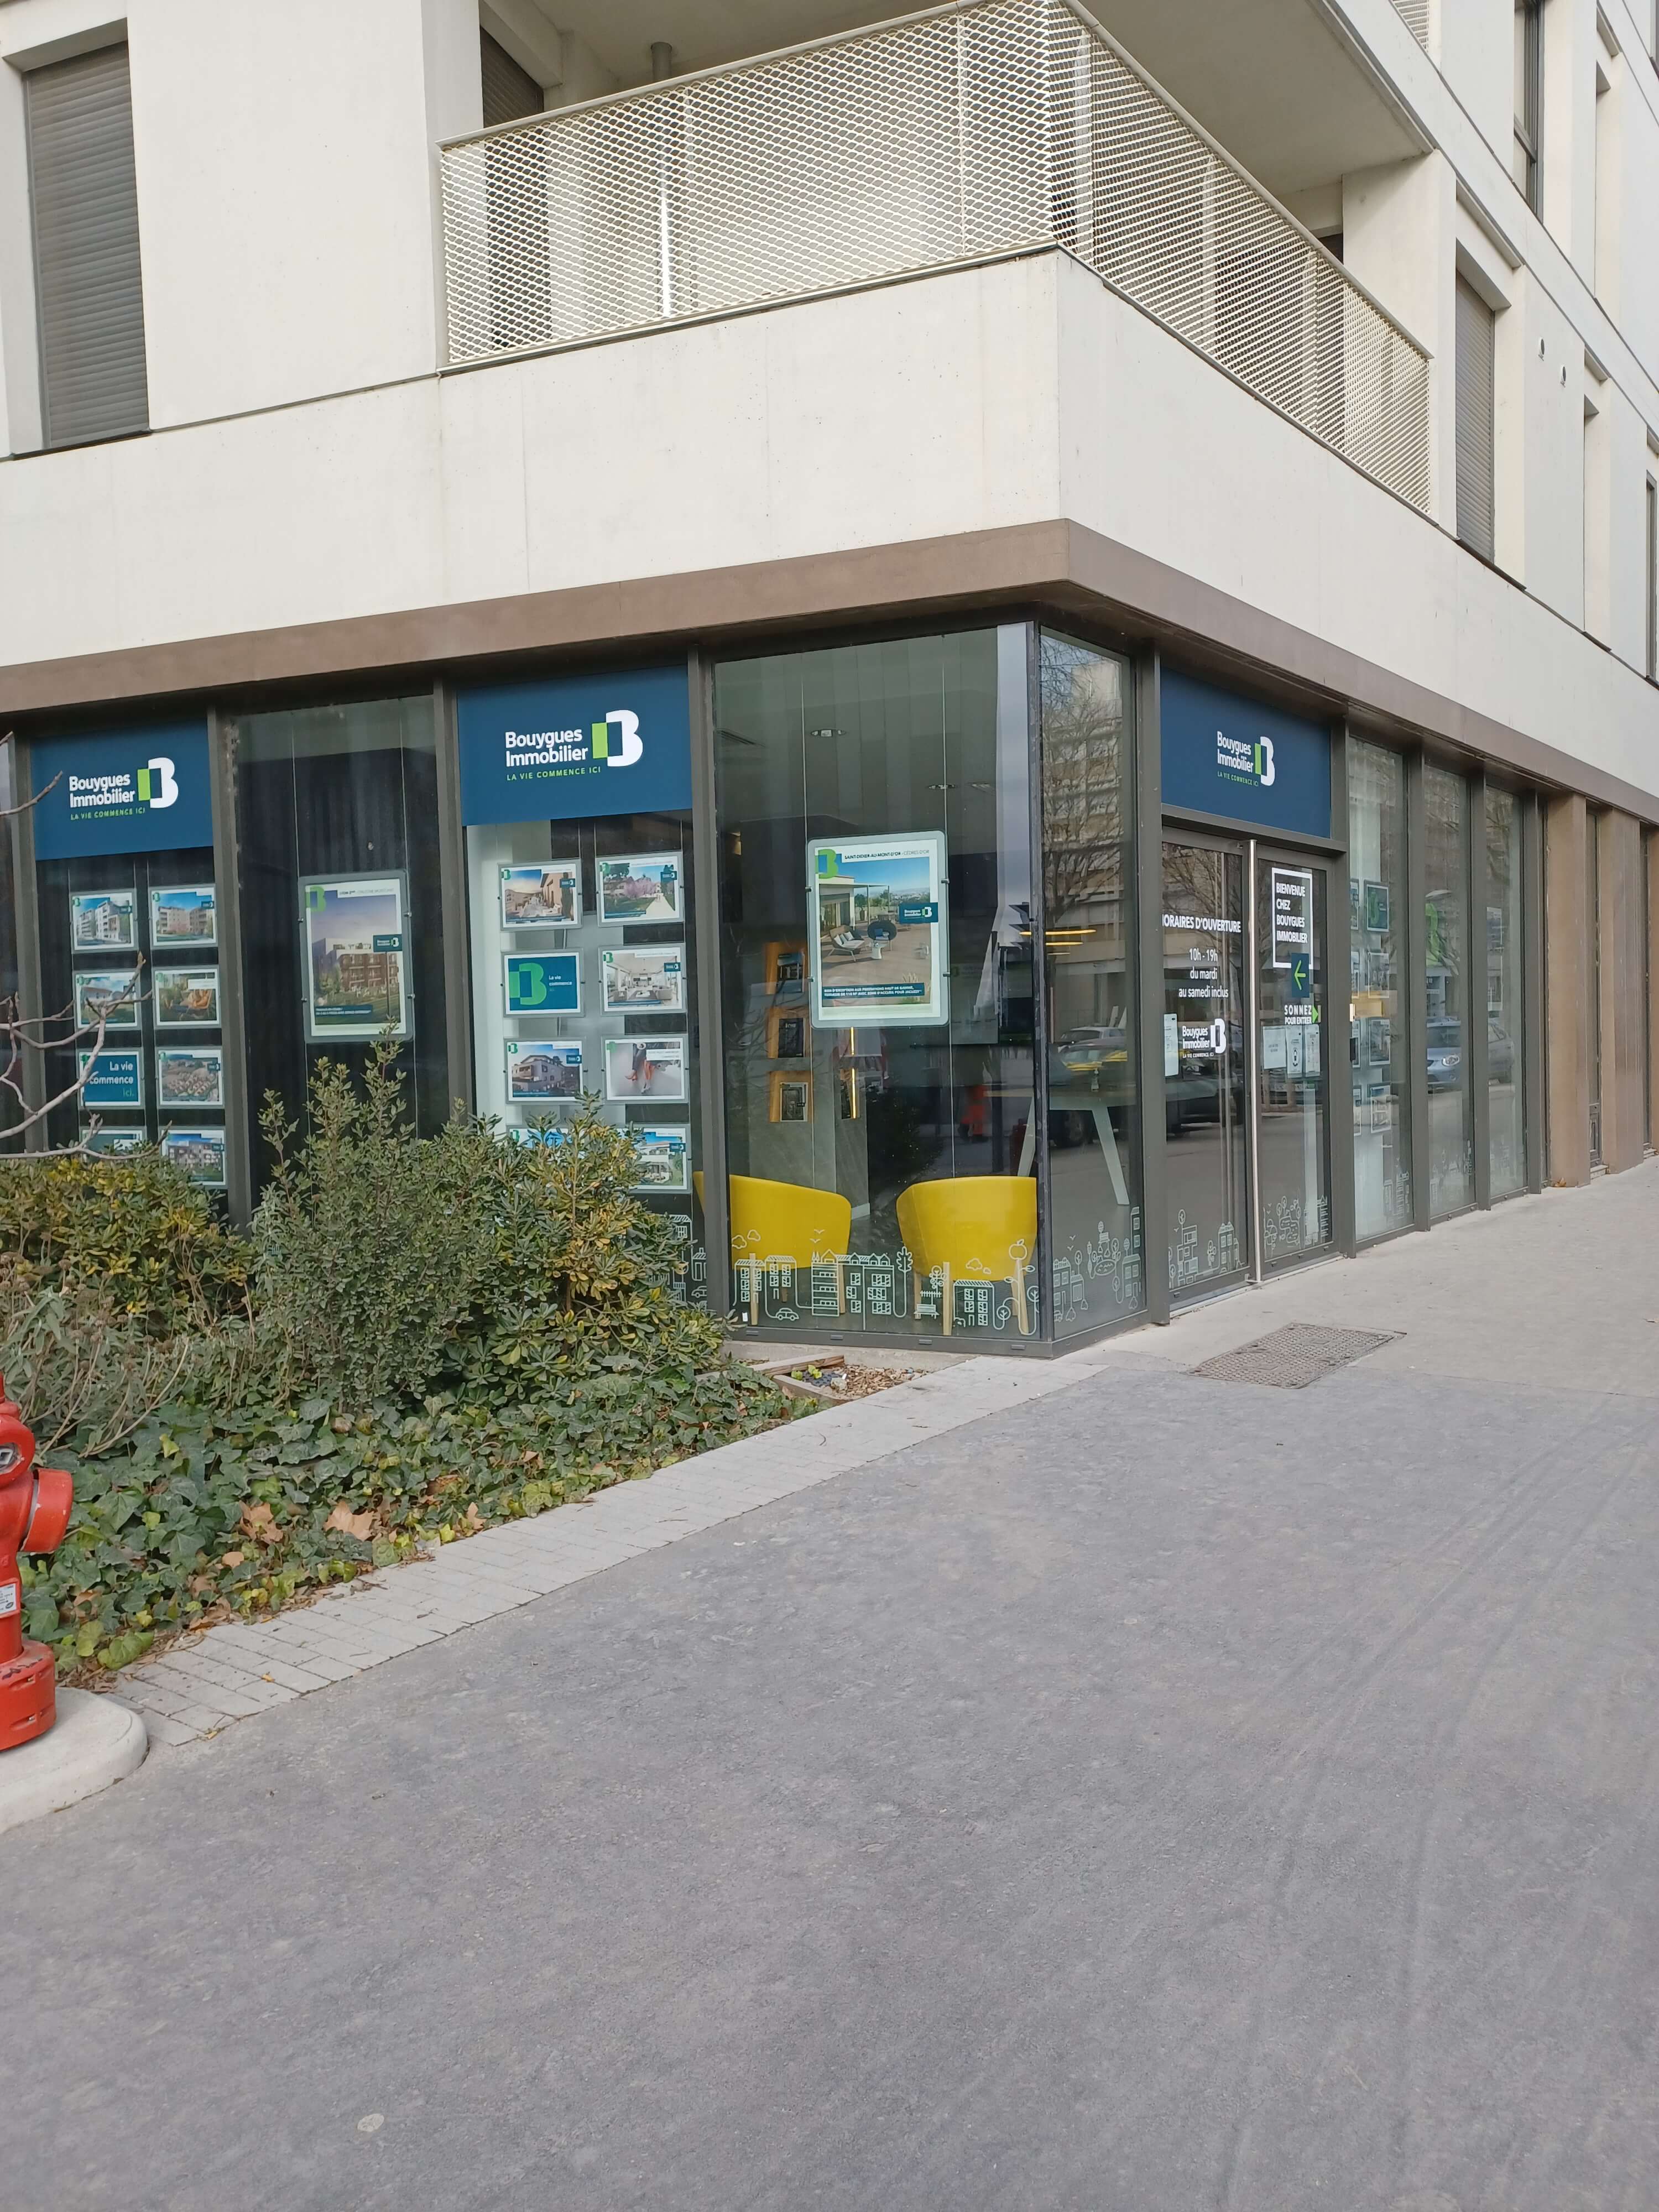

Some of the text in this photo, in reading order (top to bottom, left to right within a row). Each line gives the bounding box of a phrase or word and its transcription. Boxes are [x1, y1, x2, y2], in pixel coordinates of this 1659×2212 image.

[505, 729, 582, 749] Bouygues
[1217, 731, 1251, 755] Bouygues
[505, 744, 588, 767] Immobilier
[1217, 748, 1254, 773] Immobilier
[536, 768, 586, 778] COMMENCE
[1231, 774, 1253, 786] COMMENCE
[69, 774, 131, 792] Bouygues
[70, 788, 135, 808] Immobilier
[94, 808, 133, 818] COMMENCE
[1276, 882, 1306, 897] BIENVENUE
[1276, 898, 1291, 911] CHEZ
[1196, 917, 1241, 933] D'OUVERTURE
[1276, 914, 1305, 928] BOUYGUES
[1276, 930, 1308, 944] IMMOBILIER
[1190, 948, 1201, 961] 10h
[1206, 948, 1218, 962] 19h
[1190, 966, 1218, 979] du mardi
[1178, 985, 1229, 998] au samedi inclus
[1284, 1004, 1312, 1015] SONNEZ
[1285, 1016, 1312, 1025] POUR ENTRER
[1182, 1025, 1208, 1039] Bouygues
[1182, 1037, 1210, 1049] Immobilier
[109, 1061, 133, 1071] La vie
